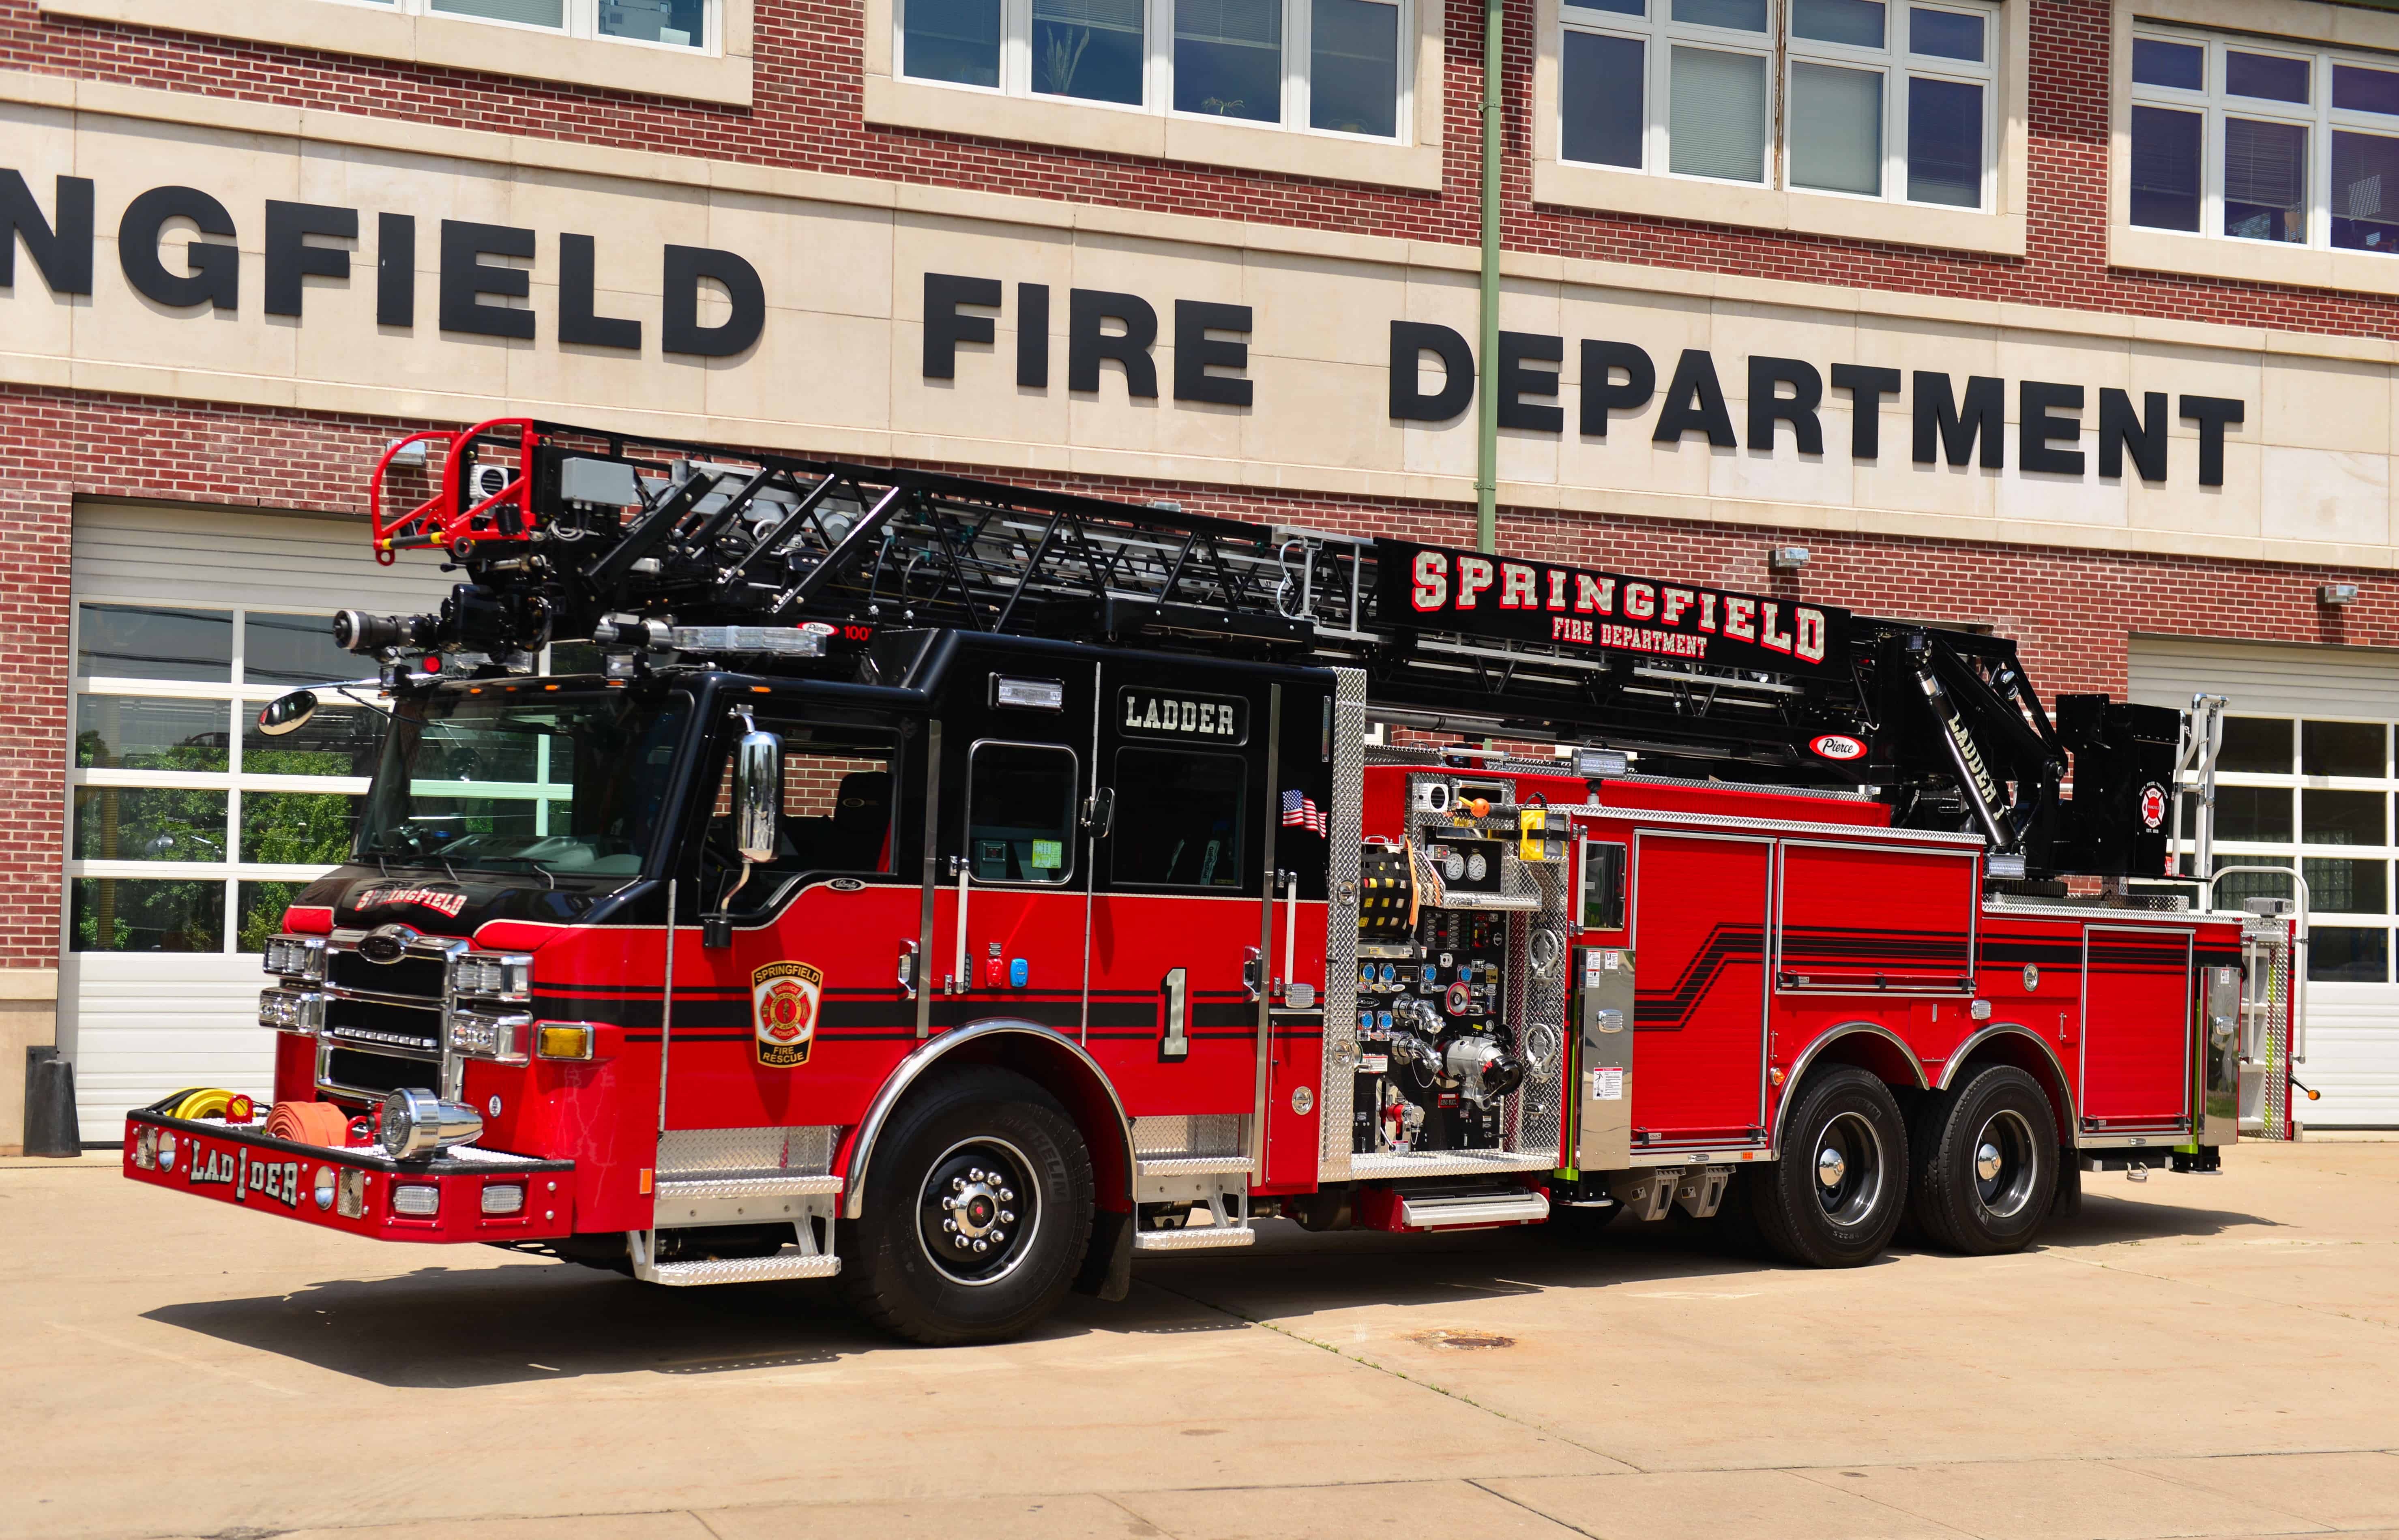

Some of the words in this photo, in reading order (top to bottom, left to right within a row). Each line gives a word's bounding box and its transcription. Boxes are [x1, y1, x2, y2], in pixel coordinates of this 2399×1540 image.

[923, 272, 1253, 406] FIRE
[1389, 320, 2245, 486] DEPARTMENT
[1411, 550, 1825, 664] SPRINGFIELD
[806, 623, 829, 633] Pierce
[1552, 616, 1593, 644] FIRE
[1600, 623, 1707, 658] DEPARTMENT
[1126, 696, 1234, 735] LADDER
[1822, 738, 1853, 753] Pierce
[1948, 710, 1997, 804] LADDER
[1993, 802, 2005, 821] 1
[354, 890, 468, 918] SPRINGFIELD
[755, 965, 819, 982] SPRINGFIELD
[1160, 967, 1188, 1060] 1
[762, 1051, 805, 1063] RESCUE
[773, 1046, 795, 1055] FIRE
